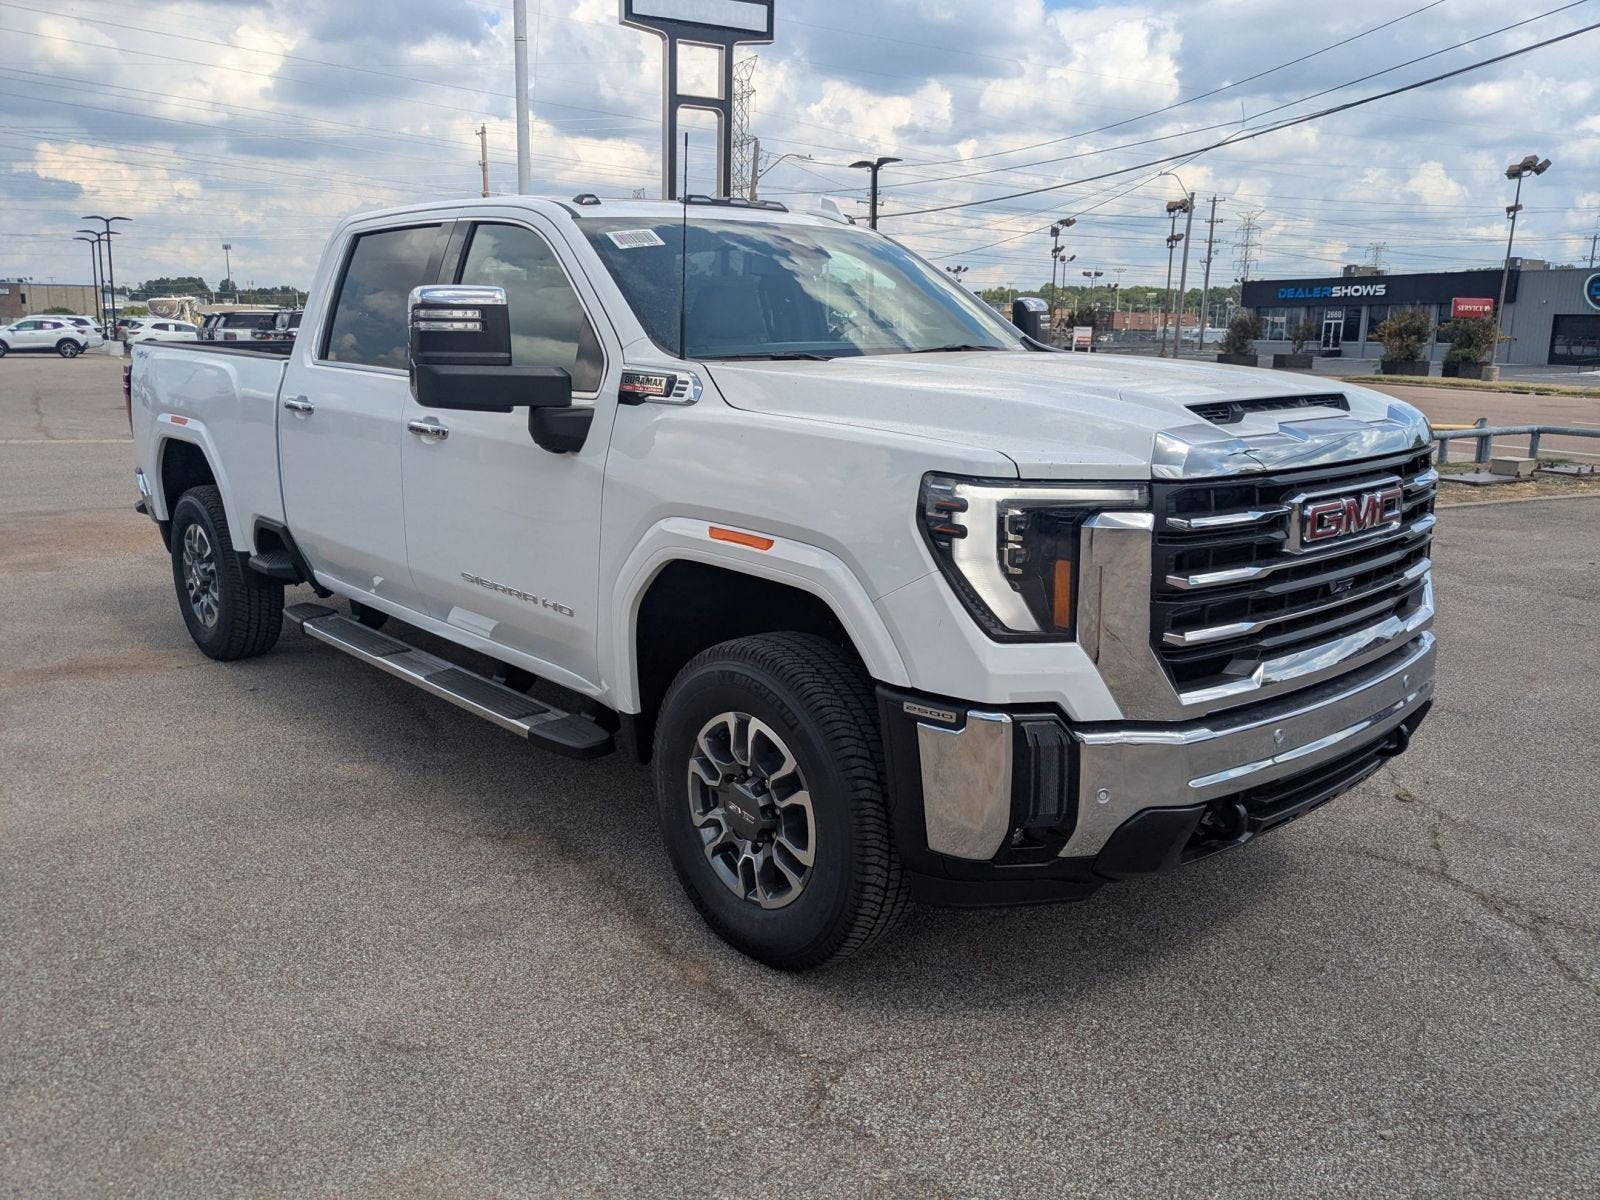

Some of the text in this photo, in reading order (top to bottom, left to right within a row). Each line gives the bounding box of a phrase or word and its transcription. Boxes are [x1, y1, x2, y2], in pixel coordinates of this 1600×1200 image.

[1278, 284, 1386, 298] DEALERSHOWS
[624, 375, 665, 388] DURAMAX
[1303, 486, 1401, 543] GMC
[461, 571, 575, 618] SIERRA HD
[905, 703, 954, 720] 2500
